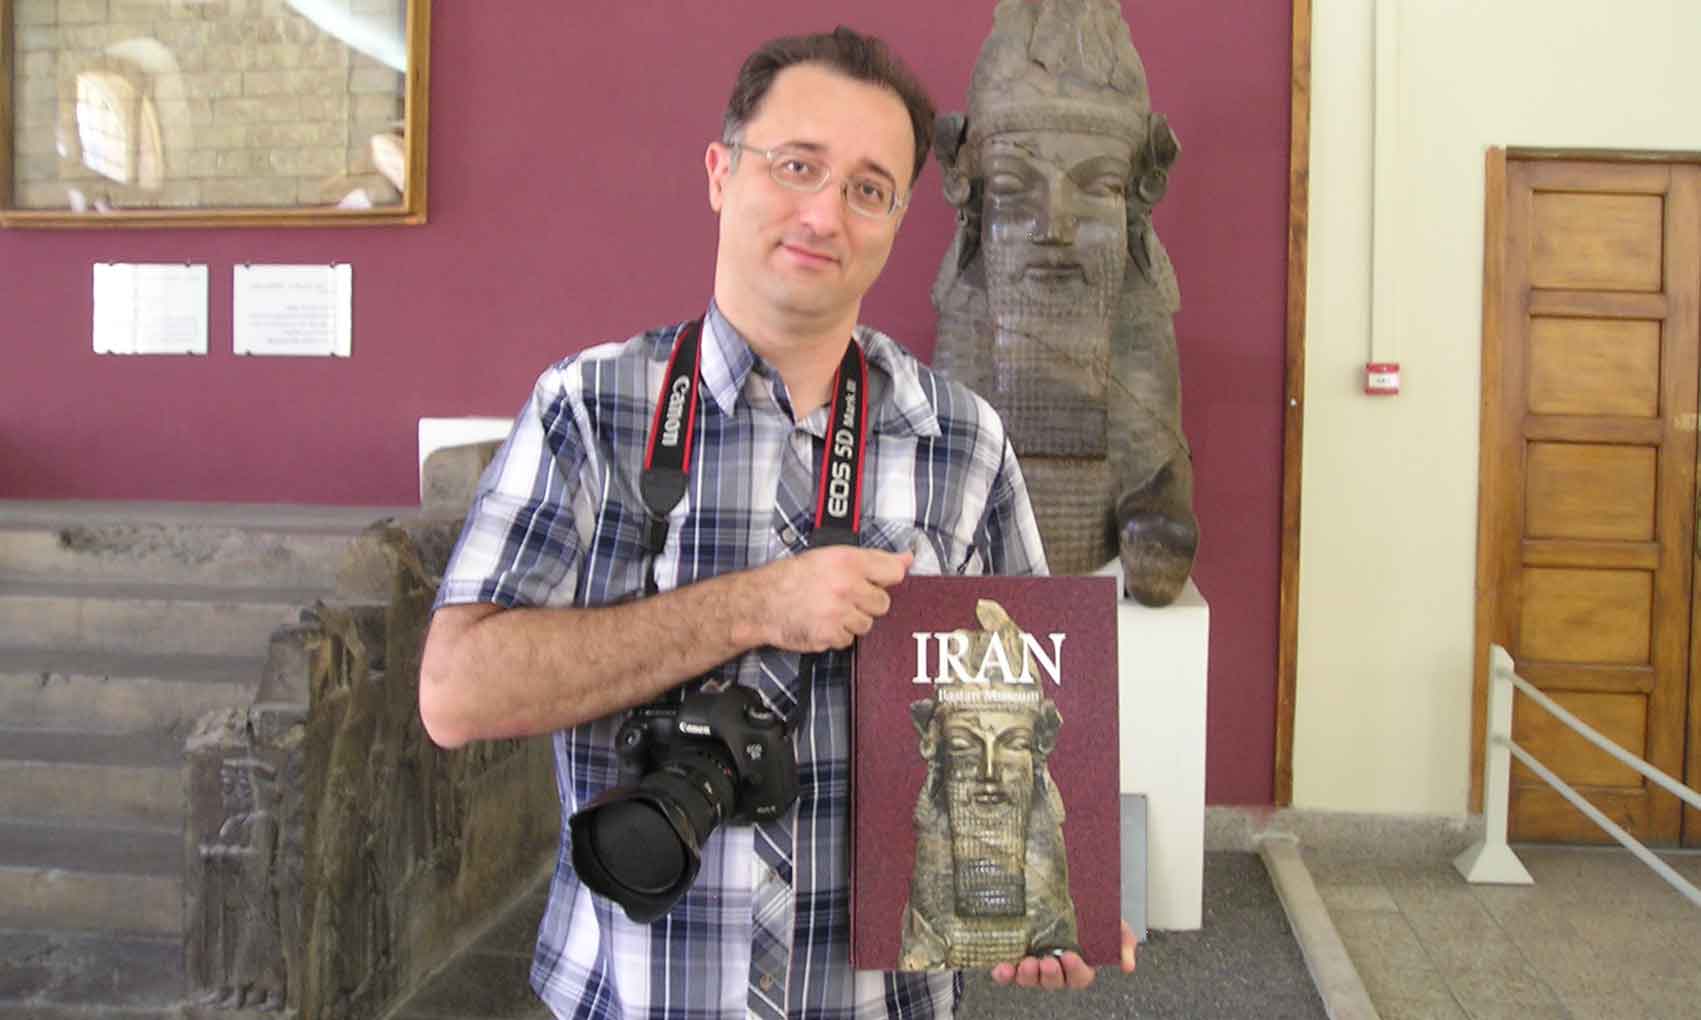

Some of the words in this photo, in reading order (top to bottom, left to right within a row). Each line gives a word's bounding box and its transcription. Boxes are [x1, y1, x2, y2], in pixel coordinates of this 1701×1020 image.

[661, 375, 690, 446] Canon
[834, 429, 854, 457] 5D
[828, 461, 851, 518] EOS
[912, 631, 1066, 686] IRAN
